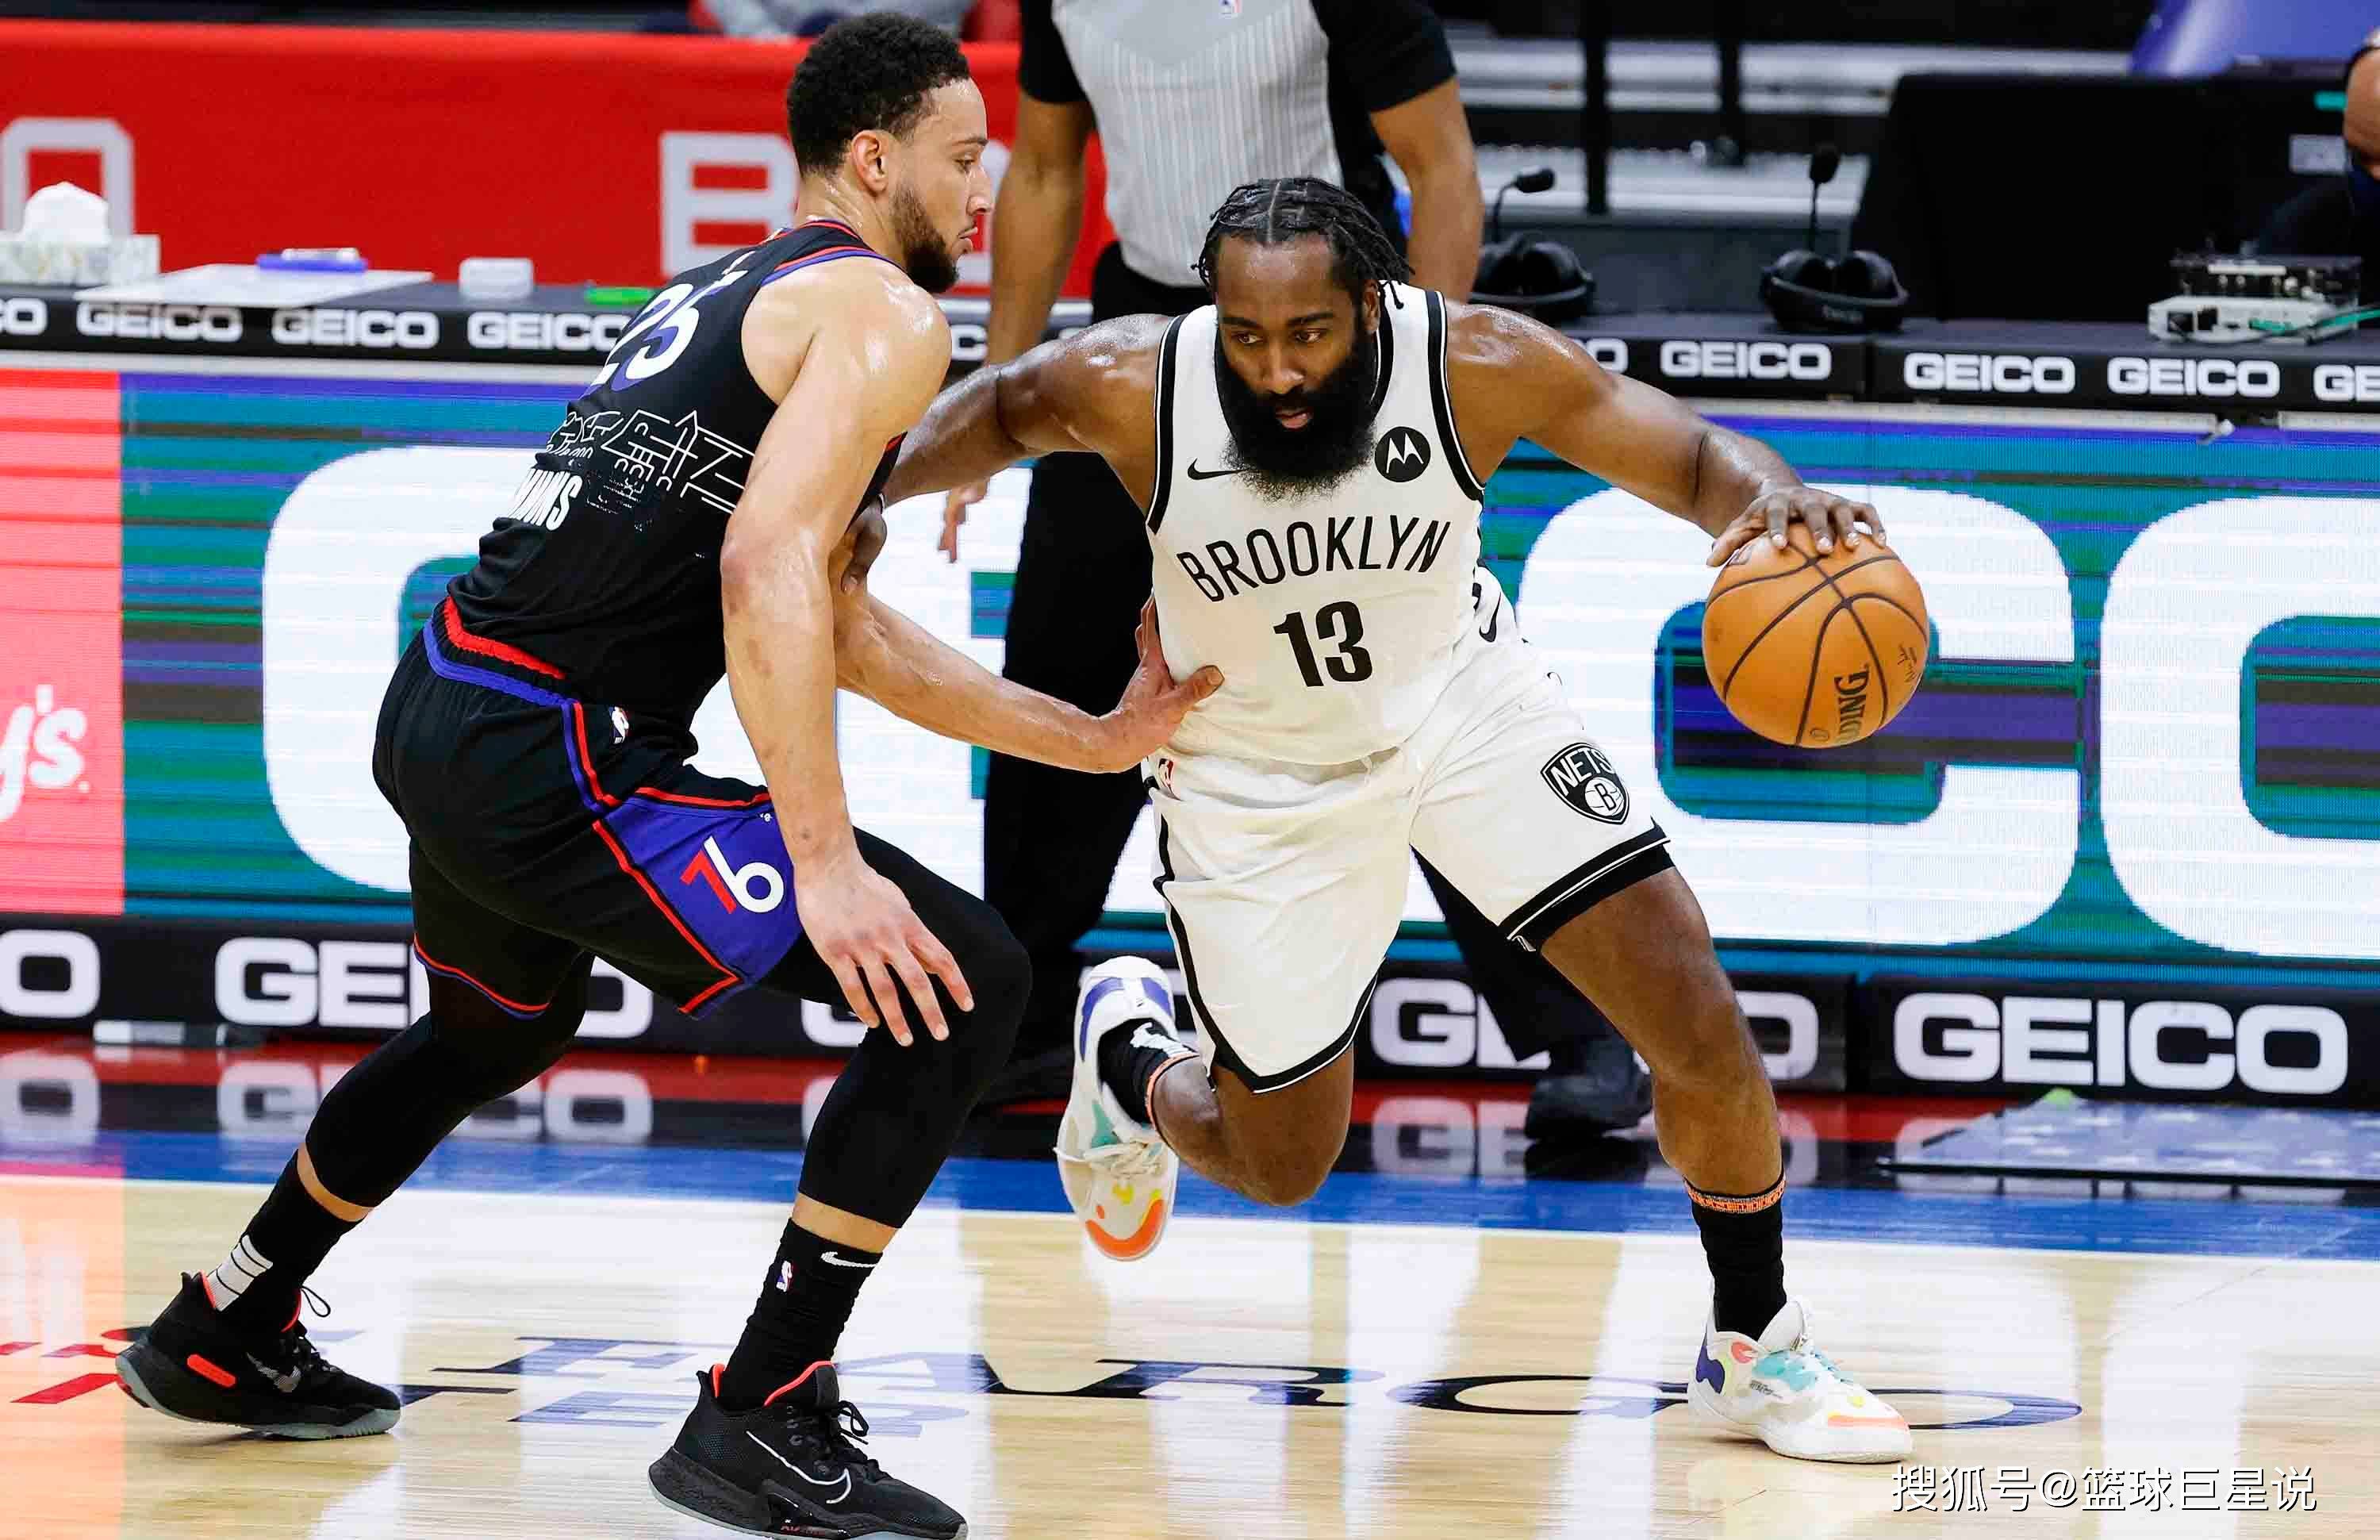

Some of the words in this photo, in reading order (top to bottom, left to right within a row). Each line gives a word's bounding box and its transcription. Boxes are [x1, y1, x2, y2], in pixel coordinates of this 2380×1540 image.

[0, 298, 47, 335] O
[76, 301, 243, 342] GEICO
[271, 308, 439, 348] GEICO
[467, 312, 631, 351] GEICO
[1660, 340, 1832, 379] GEICO
[1904, 352, 2075, 394] GEICO
[2107, 357, 2279, 397] GEICO
[1177, 514, 1451, 602] BROOKLYN
[1273, 601, 1373, 687] 13
[1550, 747, 1615, 797] NETS
[1595, 782, 1617, 811] B
[681, 835, 785, 914] 76
[215, 937, 653, 1039] GEIO
[1894, 993, 2348, 1094] GEICO
